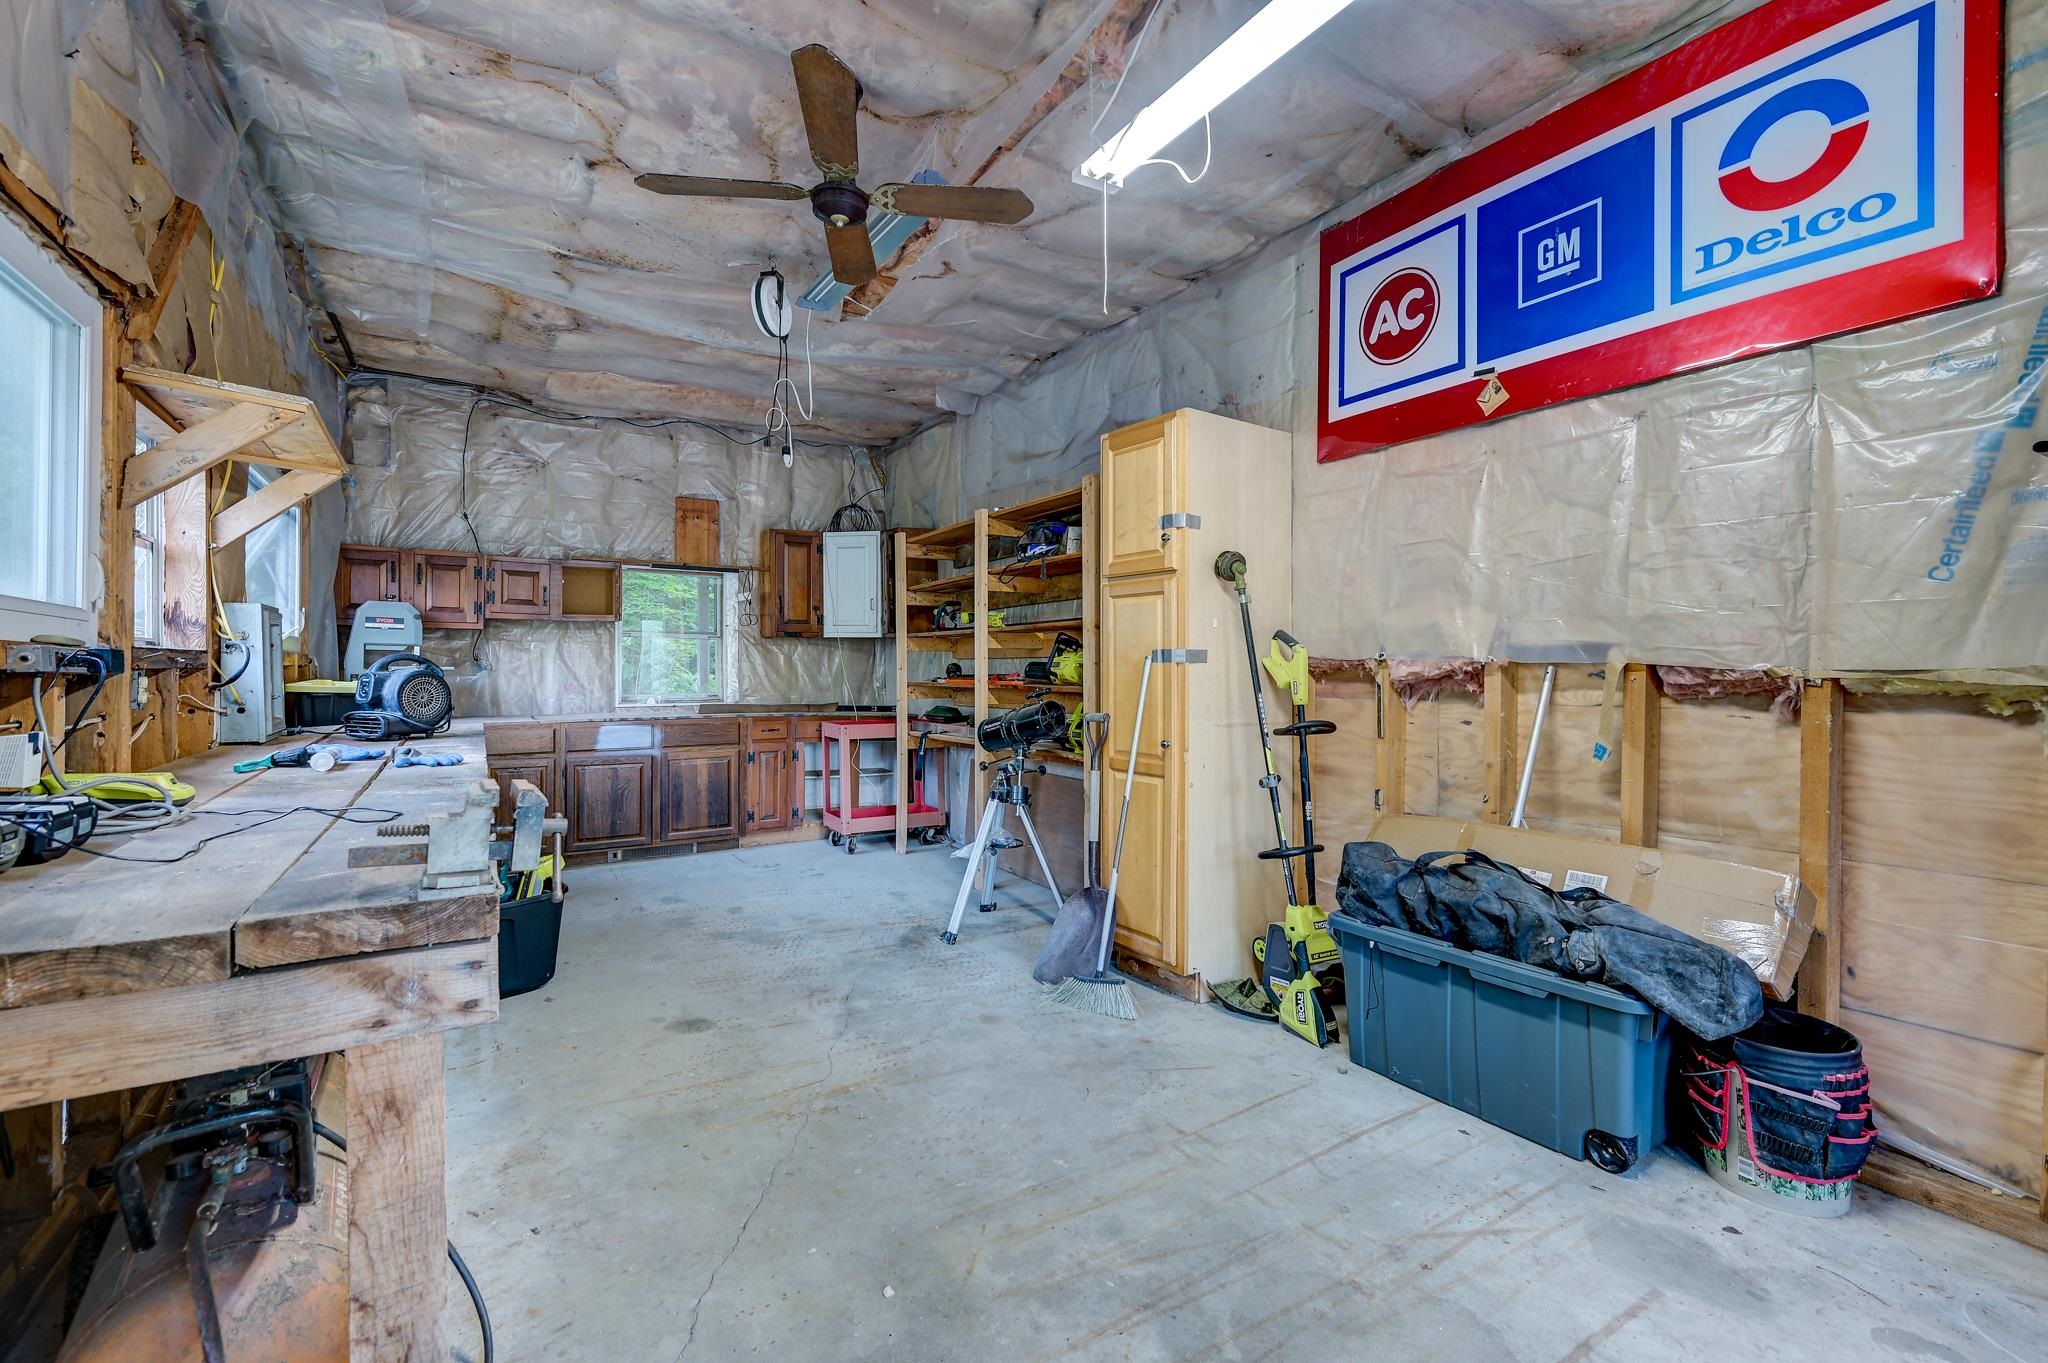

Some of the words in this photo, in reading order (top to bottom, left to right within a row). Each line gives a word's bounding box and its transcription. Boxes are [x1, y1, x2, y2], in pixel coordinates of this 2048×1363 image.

[1537, 227, 1580, 270] GM
[1695, 191, 1898, 275] Delco
[1369, 287, 1425, 345] AC
[1297, 992, 1306, 1022] RYOBI
